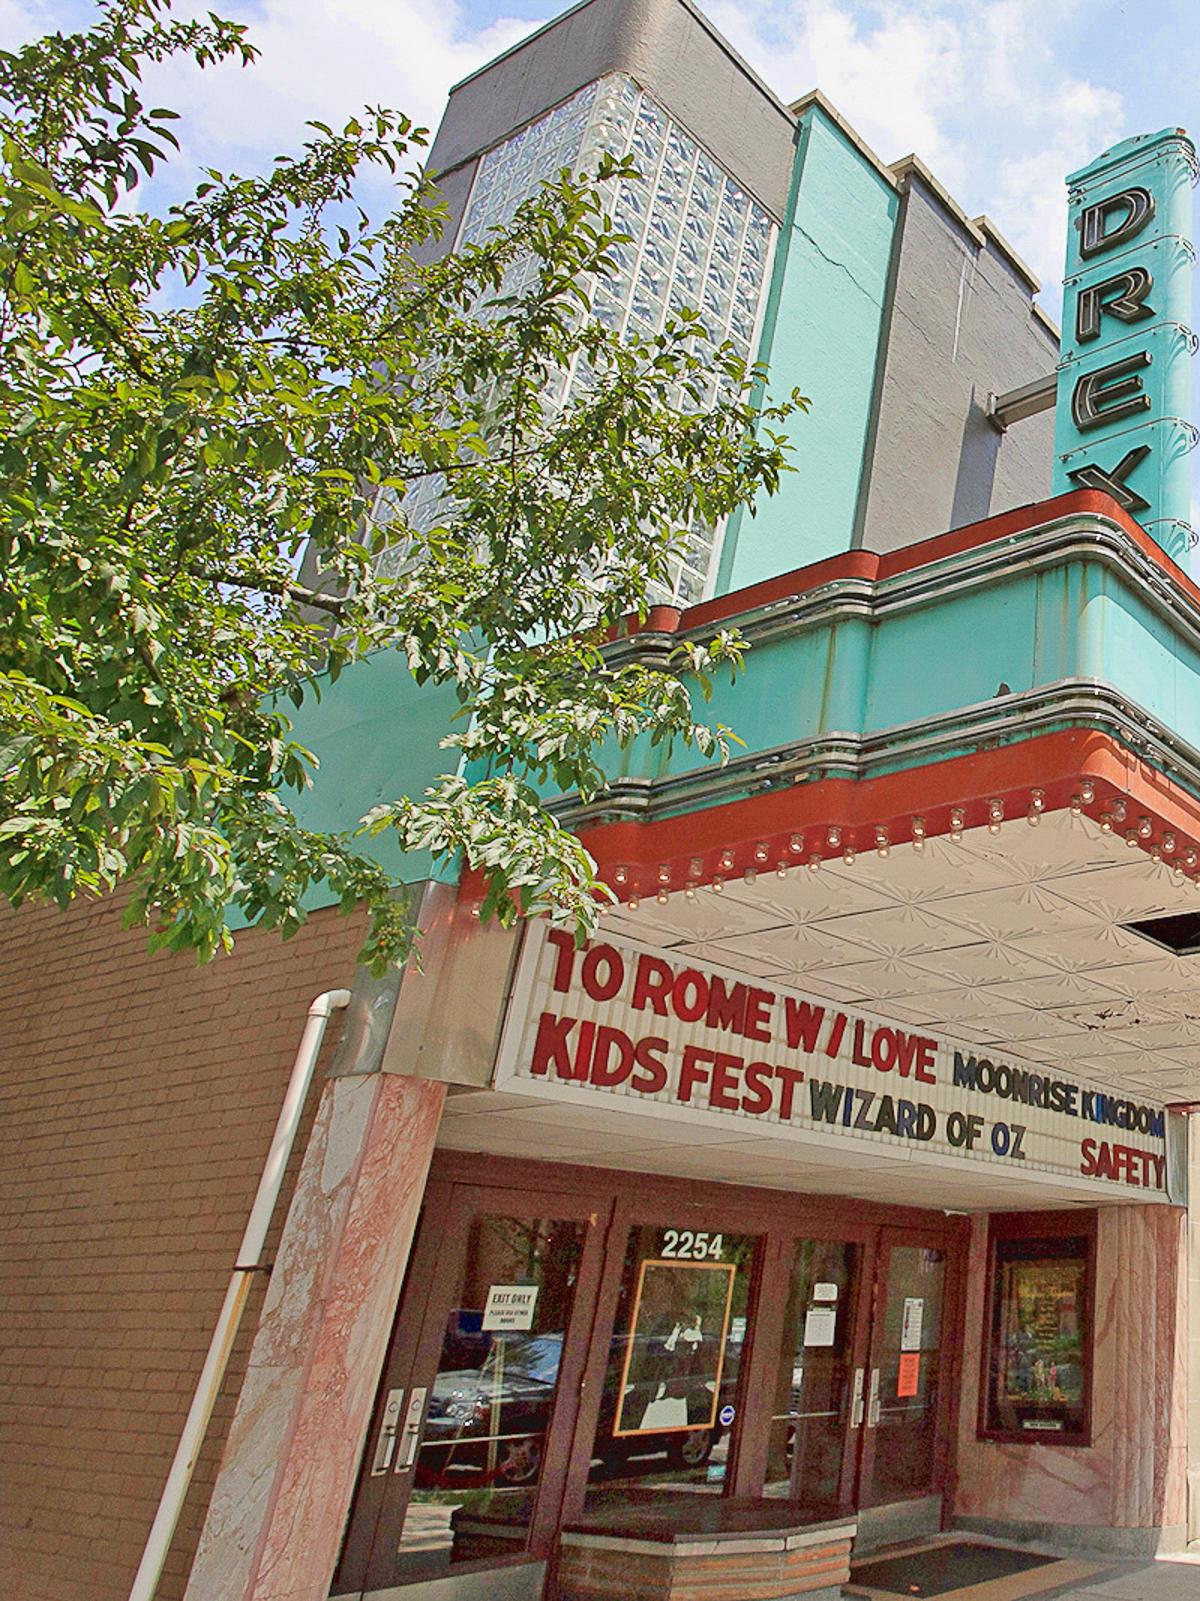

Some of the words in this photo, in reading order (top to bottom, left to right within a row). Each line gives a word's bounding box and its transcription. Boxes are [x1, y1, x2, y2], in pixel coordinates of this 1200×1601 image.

[548, 929, 625, 1002] TO
[631, 953, 776, 1043] ROME
[852, 1019, 938, 1085] LOVE
[530, 1012, 669, 1094] KIDS
[677, 1044, 804, 1121] FEST
[953, 1052, 1079, 1117] MOONRISE
[1081, 1090, 1166, 1138] KINGDOM
[810, 1079, 937, 1142] WIZARD
[946, 1112, 985, 1151] OF
[991, 1122, 1026, 1161] OZ
[1080, 1138, 1167, 1190] SAFETY
[661, 1230, 723, 1260] 2254
[492, 1293, 511, 1304] EXIT
[512, 1293, 532, 1304] ONLY
